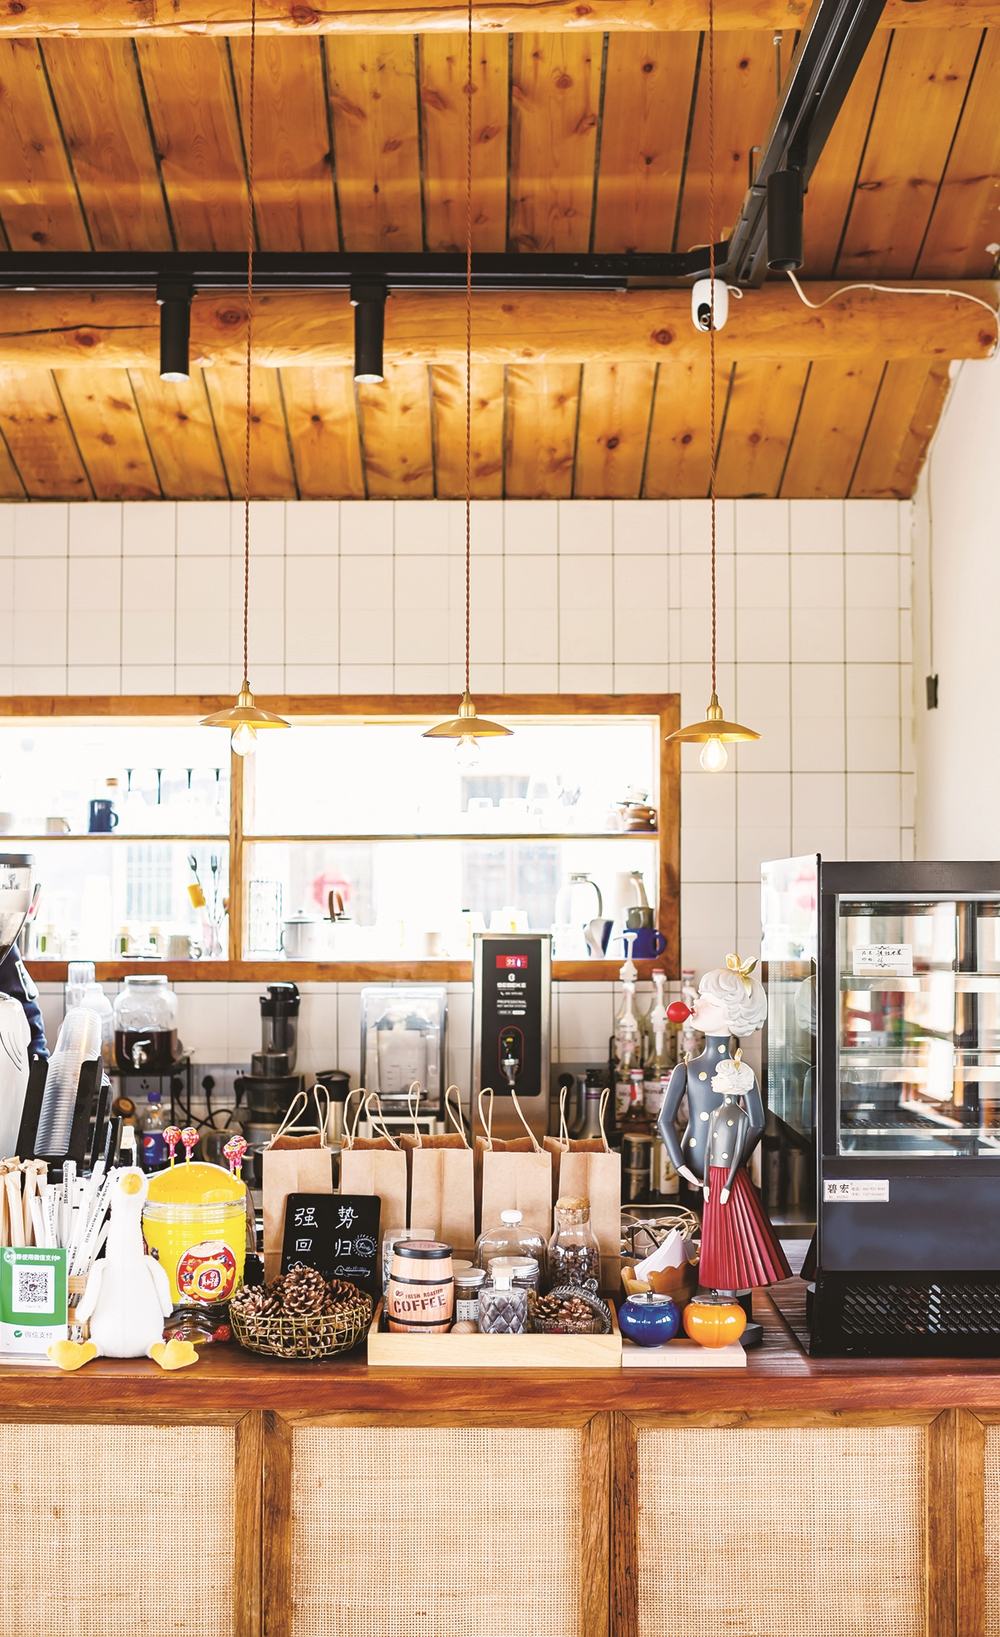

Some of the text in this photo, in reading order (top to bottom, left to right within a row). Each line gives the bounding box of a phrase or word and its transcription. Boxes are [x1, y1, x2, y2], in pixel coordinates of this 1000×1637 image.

[827, 1183, 850, 1194] 碧宏
[423, 1288, 444, 1297] ROASTED
[393, 1294, 447, 1313] COFFEE
[24, 1331, 53, 1339] 微信支付
